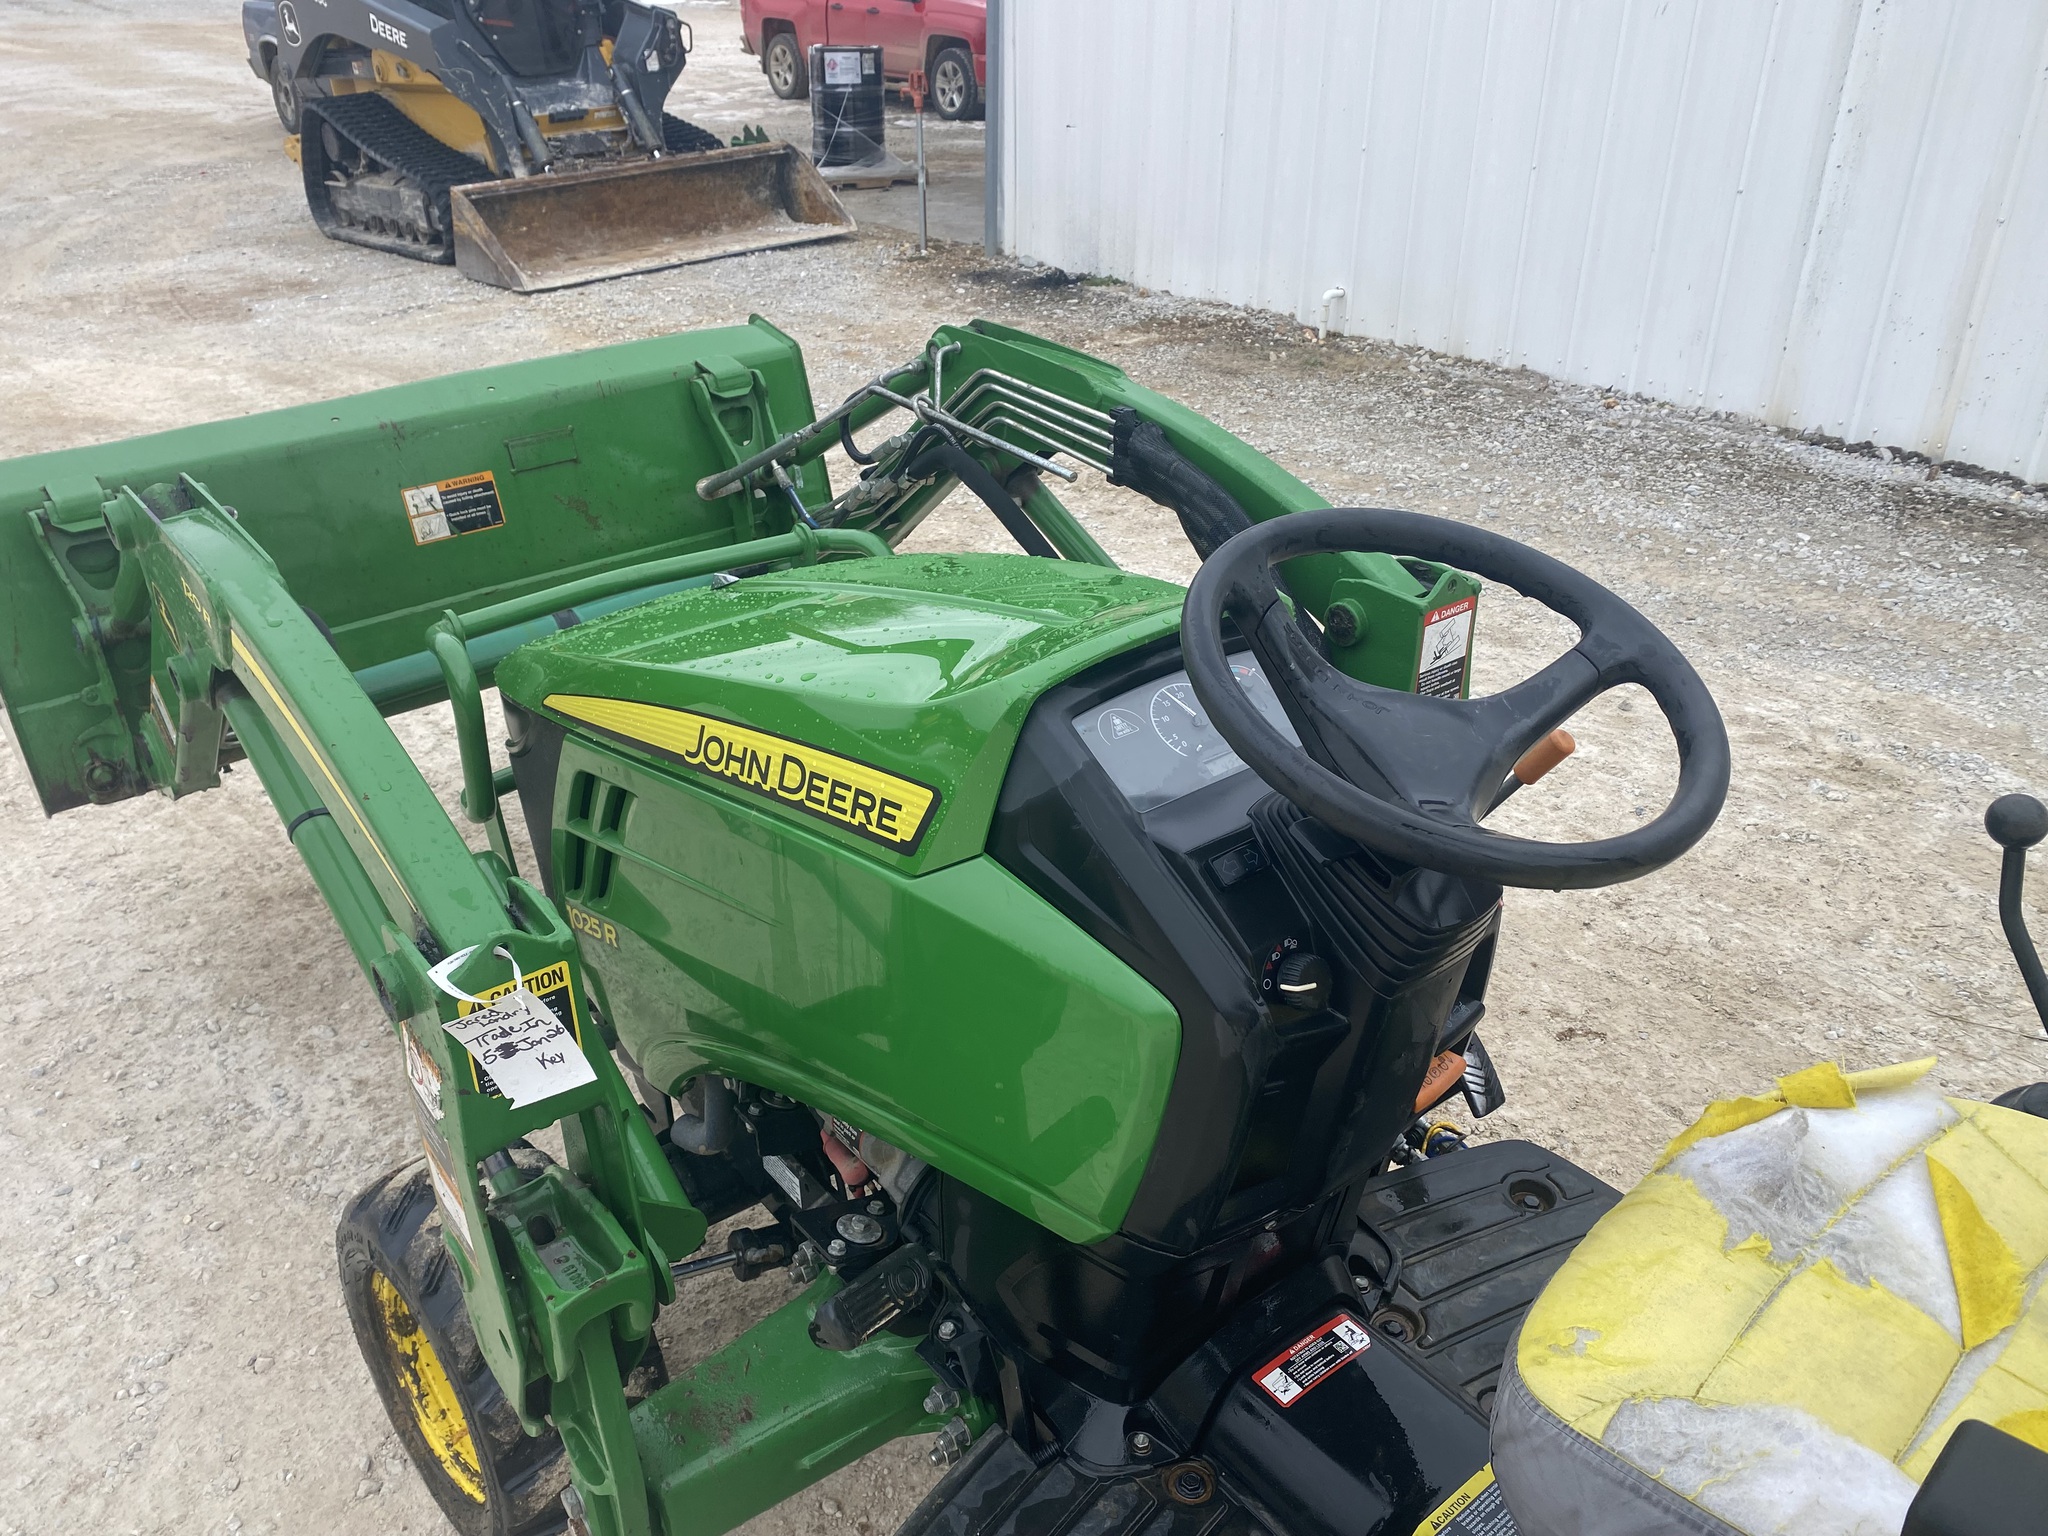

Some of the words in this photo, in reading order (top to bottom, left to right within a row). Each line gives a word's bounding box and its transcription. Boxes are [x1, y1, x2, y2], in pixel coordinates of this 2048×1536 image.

[369, 13, 408, 48] DEERE
[452, 475, 485, 487] WARNING
[203, 607, 212, 629] R
[1441, 601, 1469, 619] DANGER
[685, 725, 772, 786] JOHN
[778, 754, 903, 837] DEERE
[566, 904, 602, 939] 1025
[604, 923, 618, 948] R
[490, 967, 564, 1005] CATION
[448, 1009, 503, 1029] Jared
[464, 1026, 522, 1048] Trade
[520, 1017, 552, 1033] In
[483, 1049, 497, 1065] 5
[536, 1052, 565, 1070] Key
[1293, 1334, 1315, 1354] DANGER
[1435, 1492, 1472, 1525] CAUTION
